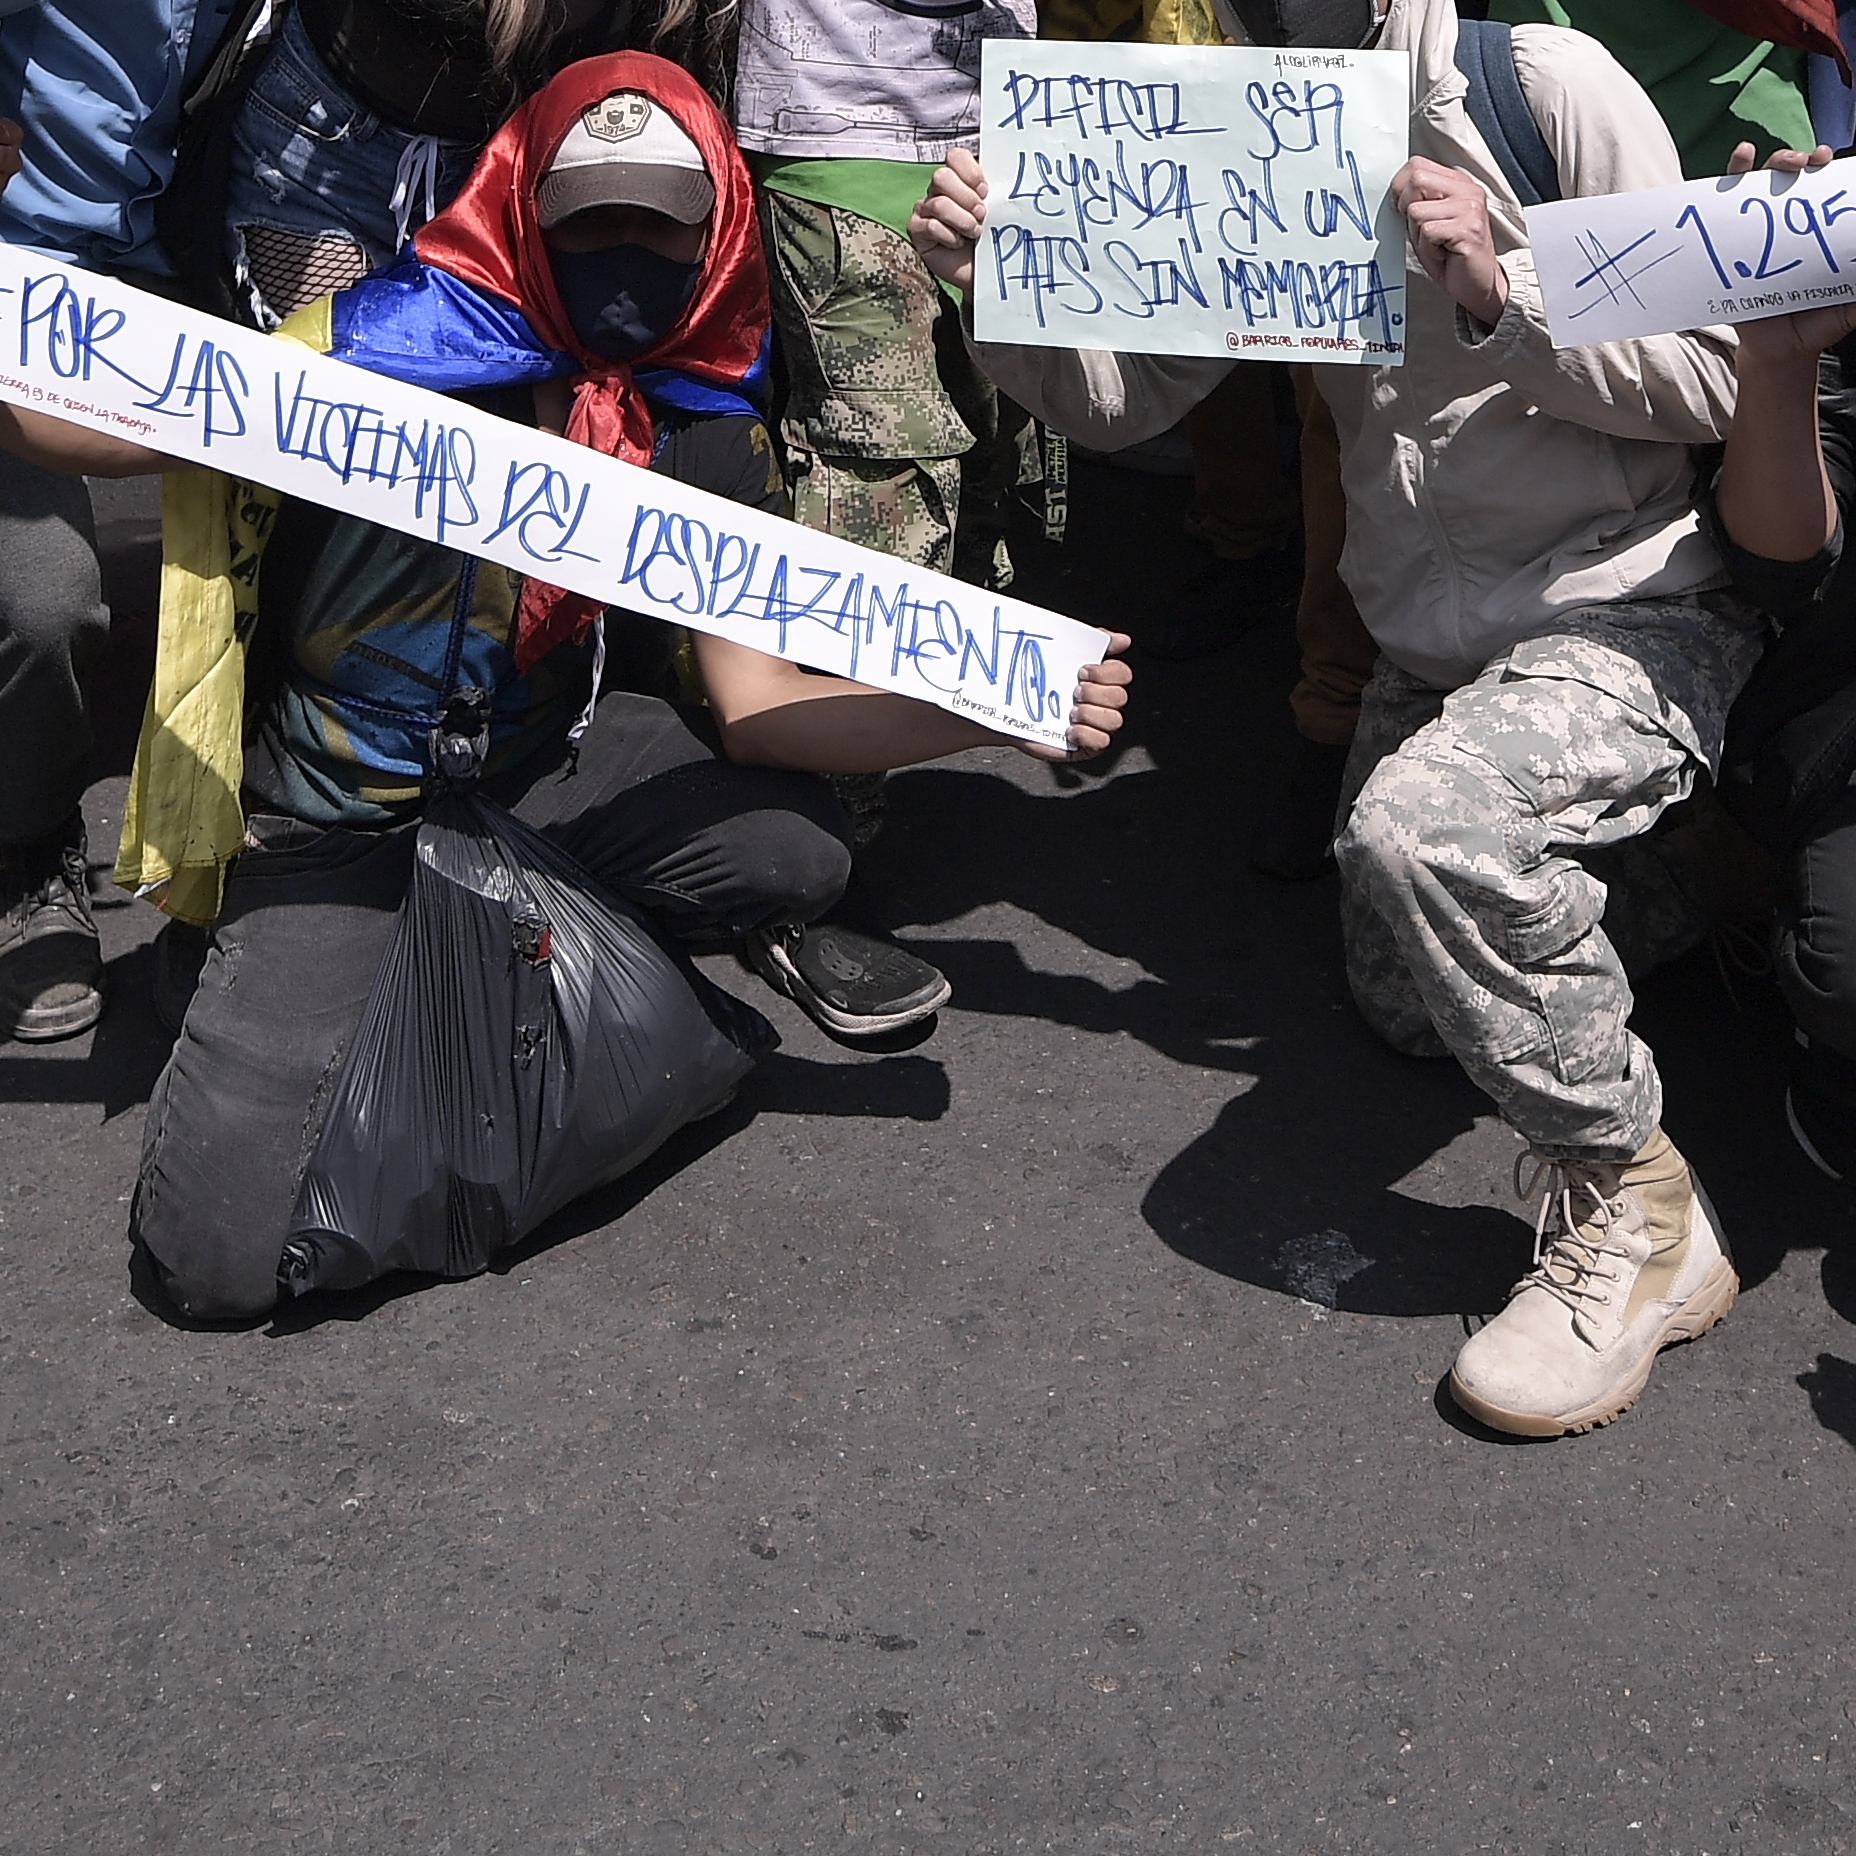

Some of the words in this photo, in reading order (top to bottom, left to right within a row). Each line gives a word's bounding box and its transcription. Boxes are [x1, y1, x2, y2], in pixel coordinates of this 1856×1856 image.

[1244, 78, 1346, 171] SER
[1006, 139, 1211, 255] LEYENDA
[1303, 148, 1375, 243] UN
[1101, 236, 1211, 321] SIN
[132, 332, 251, 448] LAS
[273, 367, 481, 546] VICTIMAS
[480, 458, 604, 565] DEL
